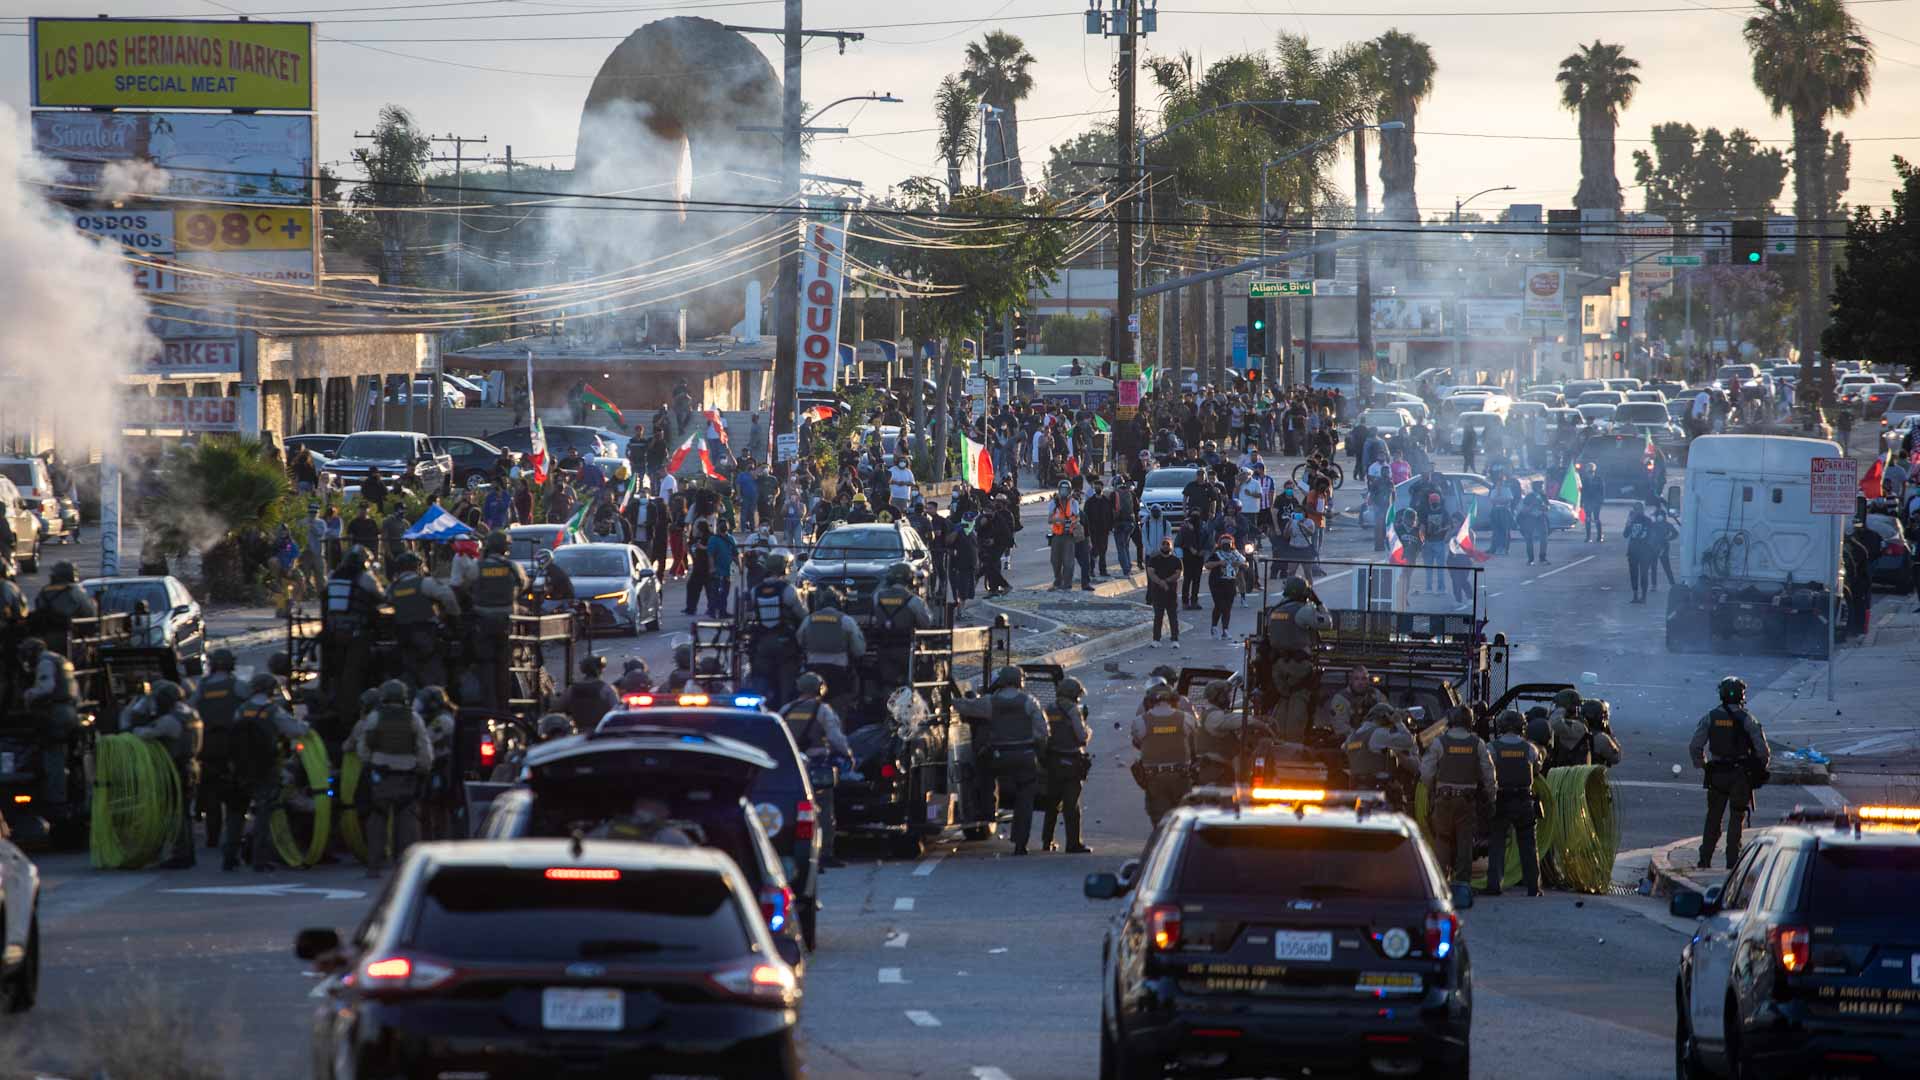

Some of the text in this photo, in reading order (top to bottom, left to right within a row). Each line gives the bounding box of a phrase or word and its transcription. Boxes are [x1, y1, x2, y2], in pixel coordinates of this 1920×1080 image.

[45, 35, 301, 84] LOS DOS HERMANOS MARKET
[115, 75, 237, 93] SPECIAL MEAT
[1252, 281, 1311, 292] Atlantic Blvd
[801, 224, 835, 387] LIQUOR
[146, 342, 236, 365] ARKET
[1812, 459, 1856, 472] NO PARKING
[1812, 473, 1856, 485] ENTIRE CITY
[1187, 964, 1287, 976] LOS ANGELES COUNTY
[1206, 978, 1267, 990] SHERIFF
[1819, 986, 1835, 997] LOS
[1840, 987, 1881, 998] ANGELES
[1840, 1001, 1903, 1014] SHERIFF
